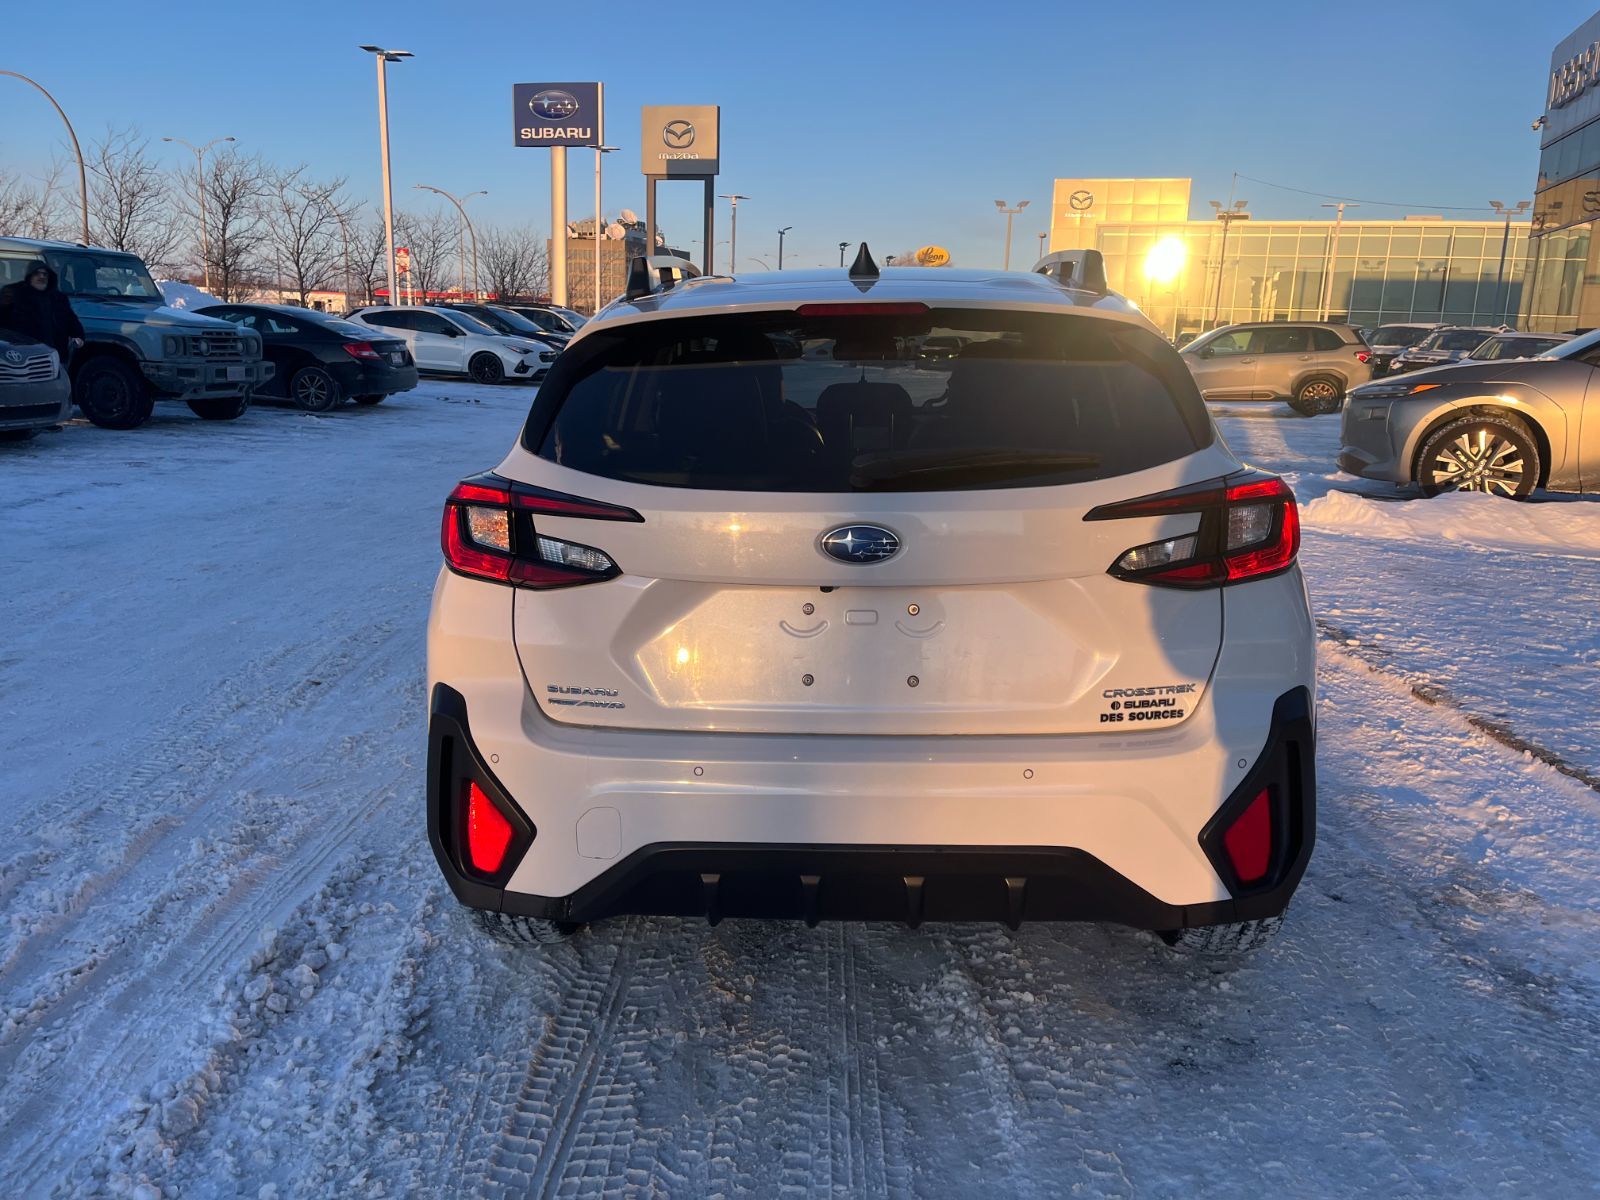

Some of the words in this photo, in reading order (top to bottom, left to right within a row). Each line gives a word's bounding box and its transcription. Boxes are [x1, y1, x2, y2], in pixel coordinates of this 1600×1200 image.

[520, 127, 591, 139] SUBARU
[546, 684, 619, 697] SUBARU
[1103, 683, 1196, 698] CROSSTREK
[1123, 698, 1176, 710] SUBARU
[1100, 713, 1124, 723] DES
[1128, 709, 1184, 721] SOURCES
